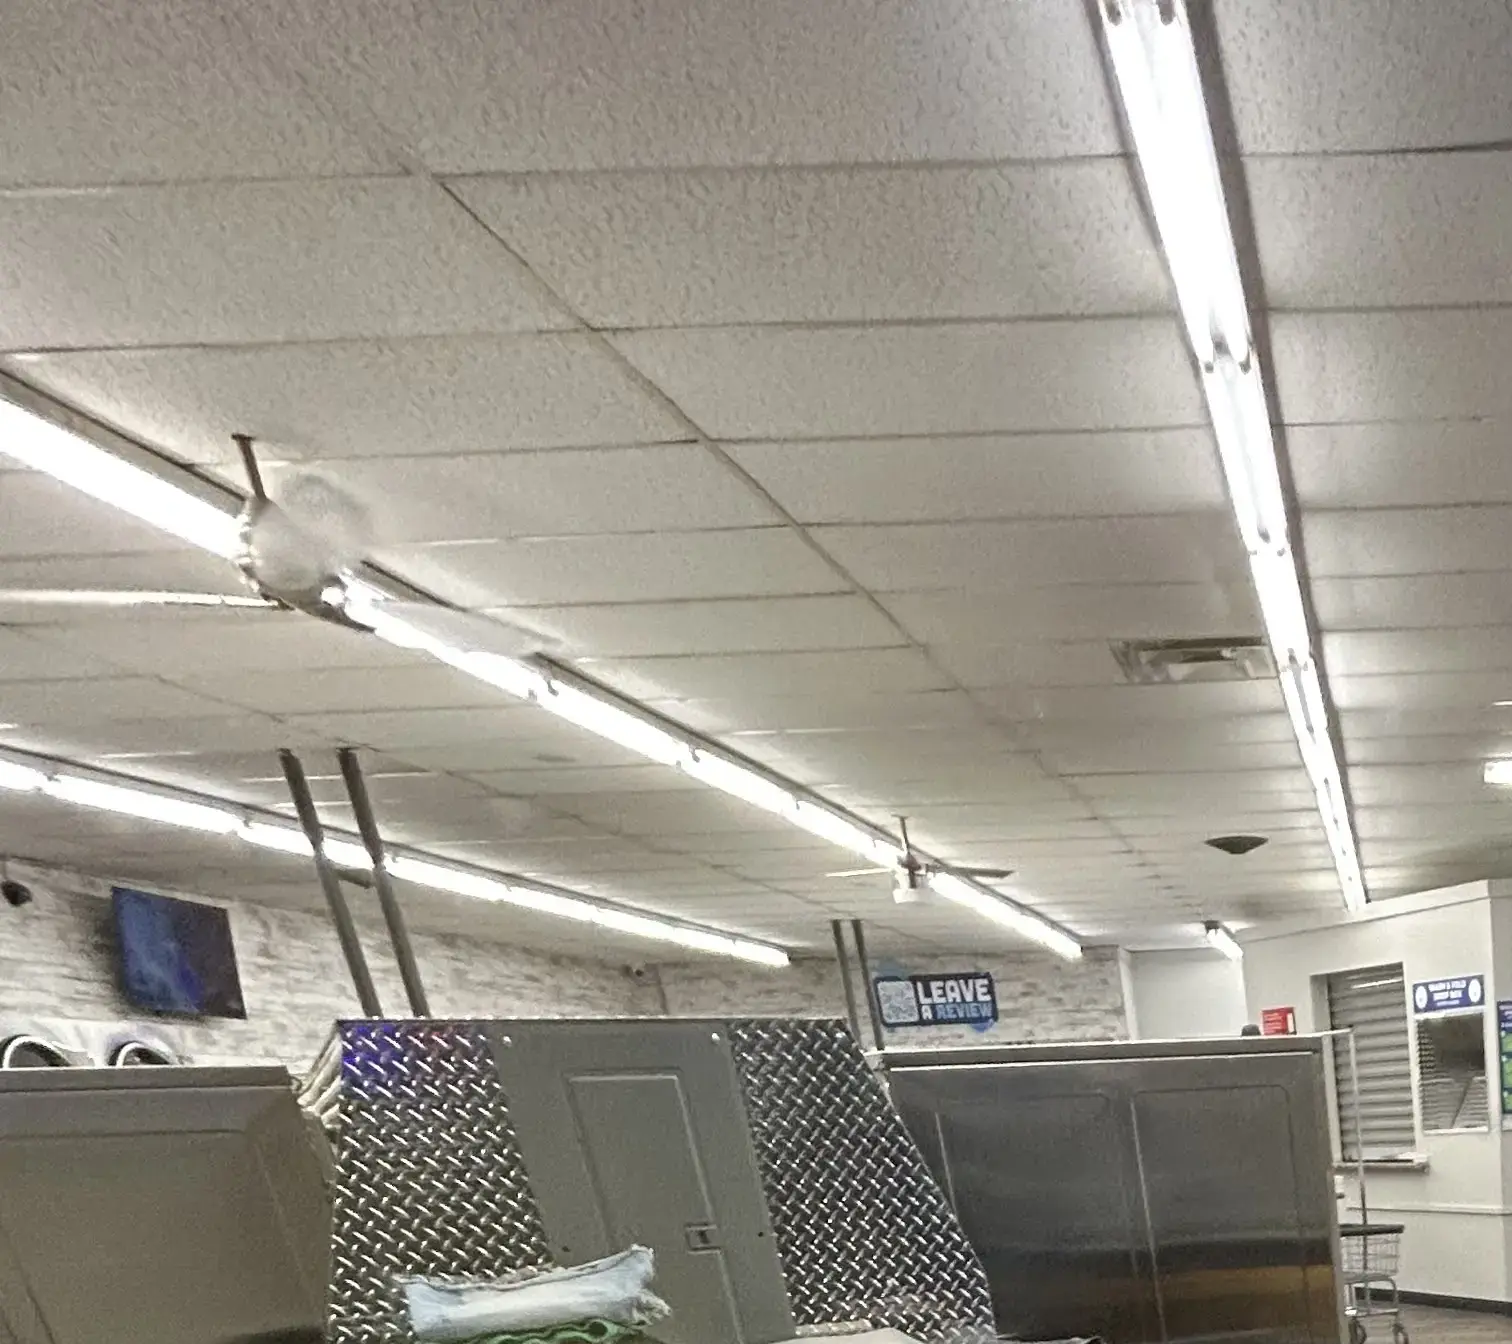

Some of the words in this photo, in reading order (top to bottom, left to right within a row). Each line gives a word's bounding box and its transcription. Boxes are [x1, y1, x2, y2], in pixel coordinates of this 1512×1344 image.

[916, 979, 992, 1005] LEAVE
[921, 1004, 932, 1020] A
[935, 1002, 993, 1019] REVIEW
